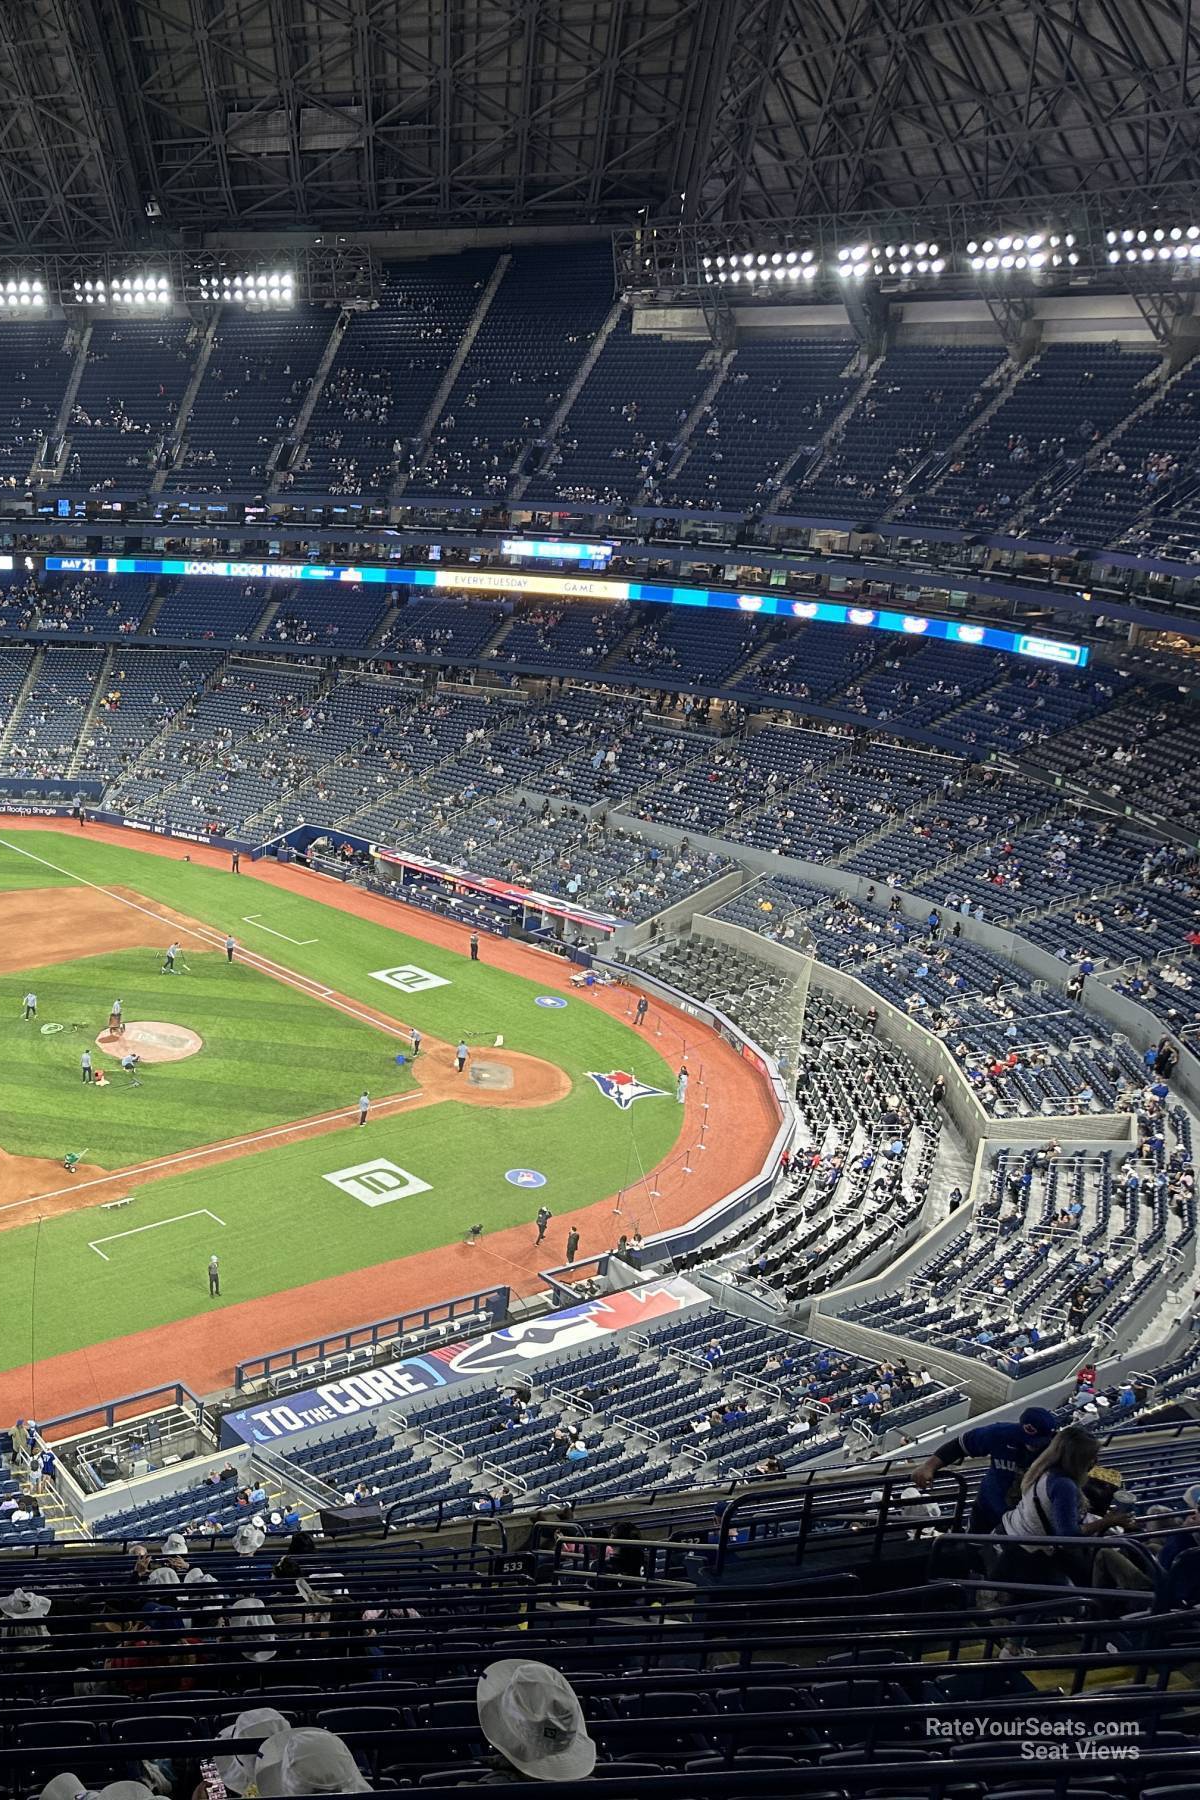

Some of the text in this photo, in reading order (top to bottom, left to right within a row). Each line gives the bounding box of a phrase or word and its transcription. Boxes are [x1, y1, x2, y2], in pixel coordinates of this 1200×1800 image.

[61, 558, 96, 572] MAY 21
[184, 562, 304, 579] LOONIE DOGS NIGHT
[454, 576, 529, 588] EVERY TUESDAY
[563, 582, 596, 593] GAME
[30, 806, 58, 817] Shingle
[385, 970, 431, 989] TD
[338, 1163, 410, 1195] TD
[251, 1363, 428, 1436] TO THE CORE
[503, 1561, 523, 1572] 533
